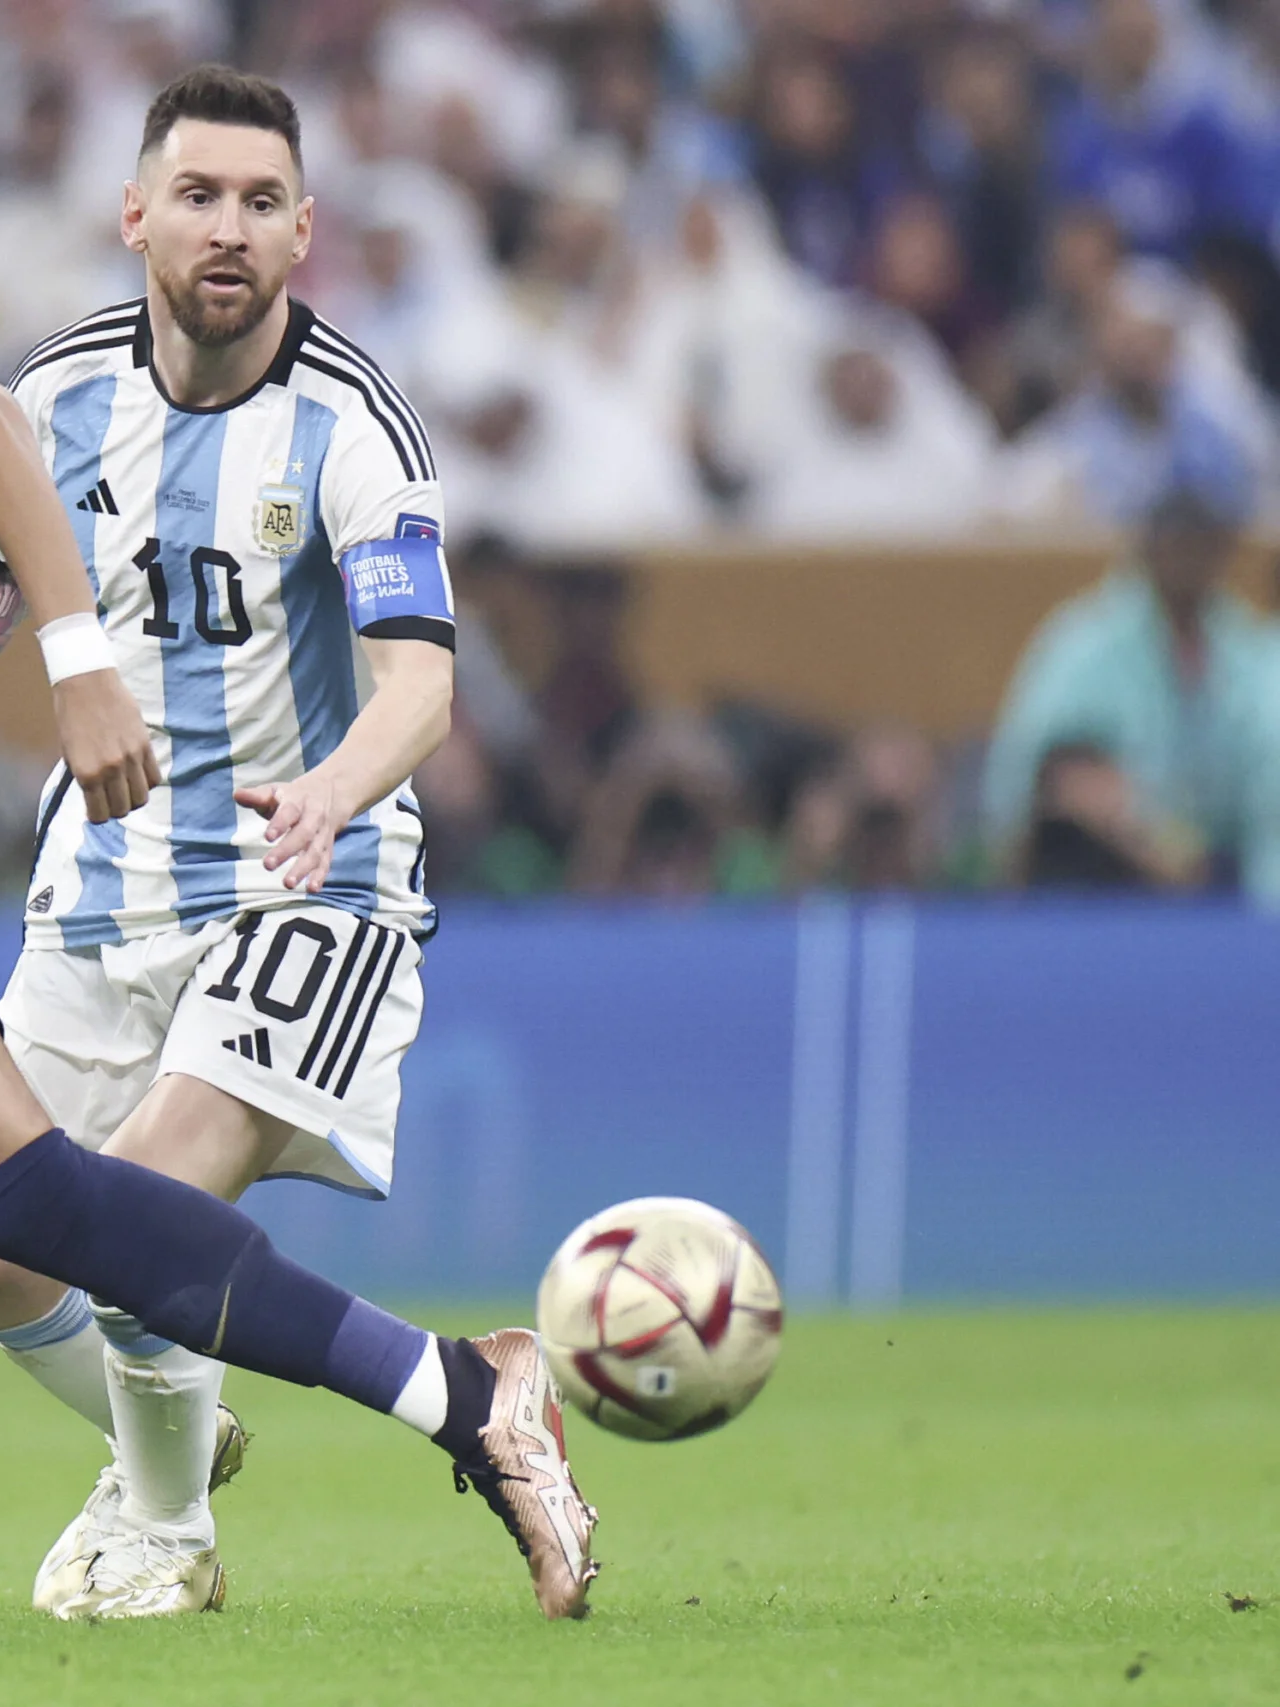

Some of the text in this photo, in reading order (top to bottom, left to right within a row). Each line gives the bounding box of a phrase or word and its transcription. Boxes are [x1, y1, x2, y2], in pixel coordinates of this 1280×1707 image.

[263, 502, 295, 537] AFA
[351, 553, 405, 575] FOOTBALL
[353, 566, 410, 590] UNITES
[131, 537, 253, 646] 10
[358, 582, 415, 604] the World
[204, 911, 338, 1023] 10
